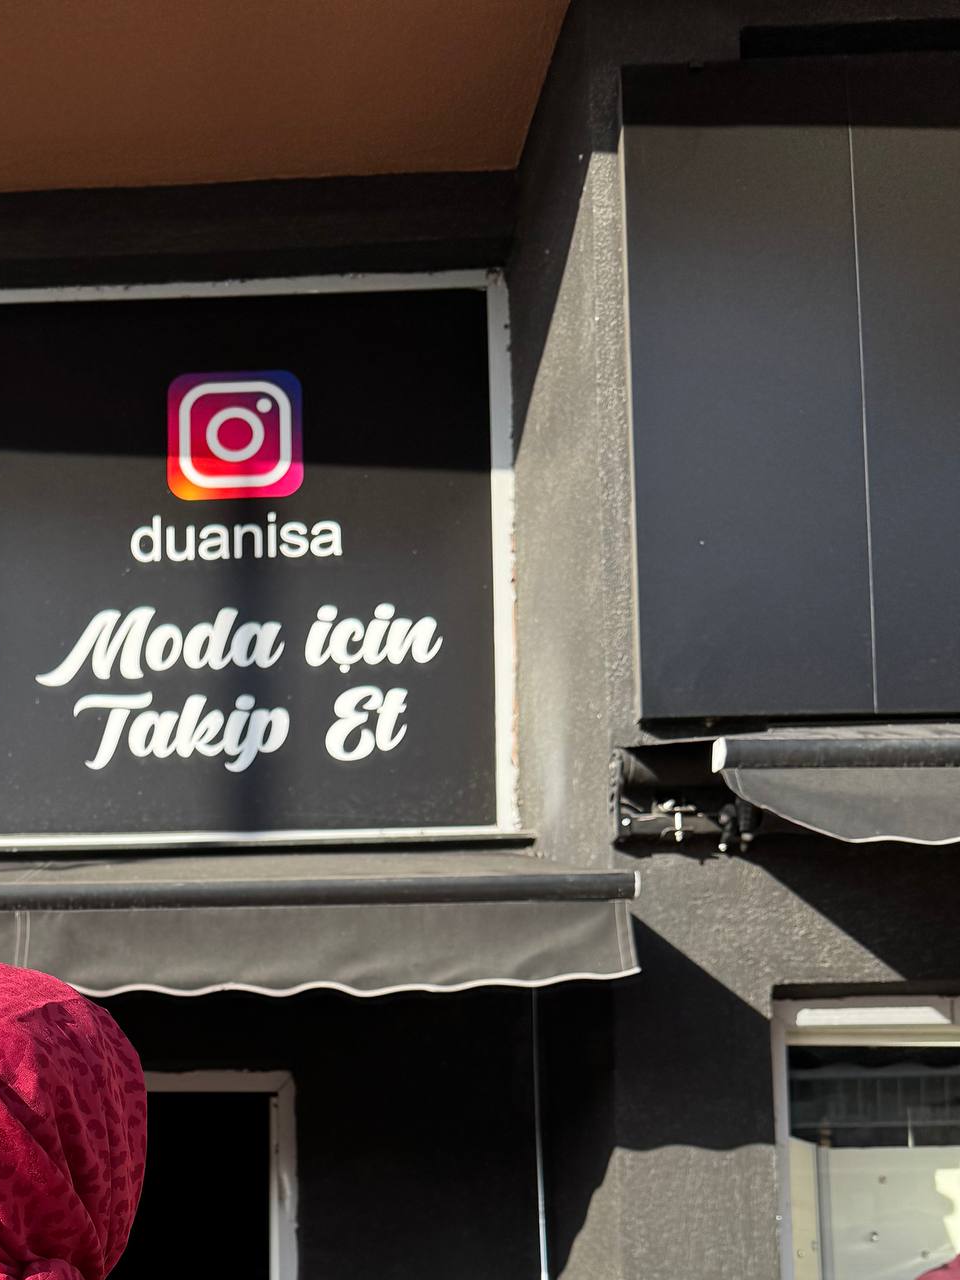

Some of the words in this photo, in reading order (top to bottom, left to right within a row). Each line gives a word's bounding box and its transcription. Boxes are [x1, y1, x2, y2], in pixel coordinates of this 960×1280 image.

[130, 512, 343, 563] duanisa
[35, 605, 286, 687] Moda
[304, 602, 444, 674] için
[72, 690, 290, 773] Takip
[324, 685, 409, 762] Et
